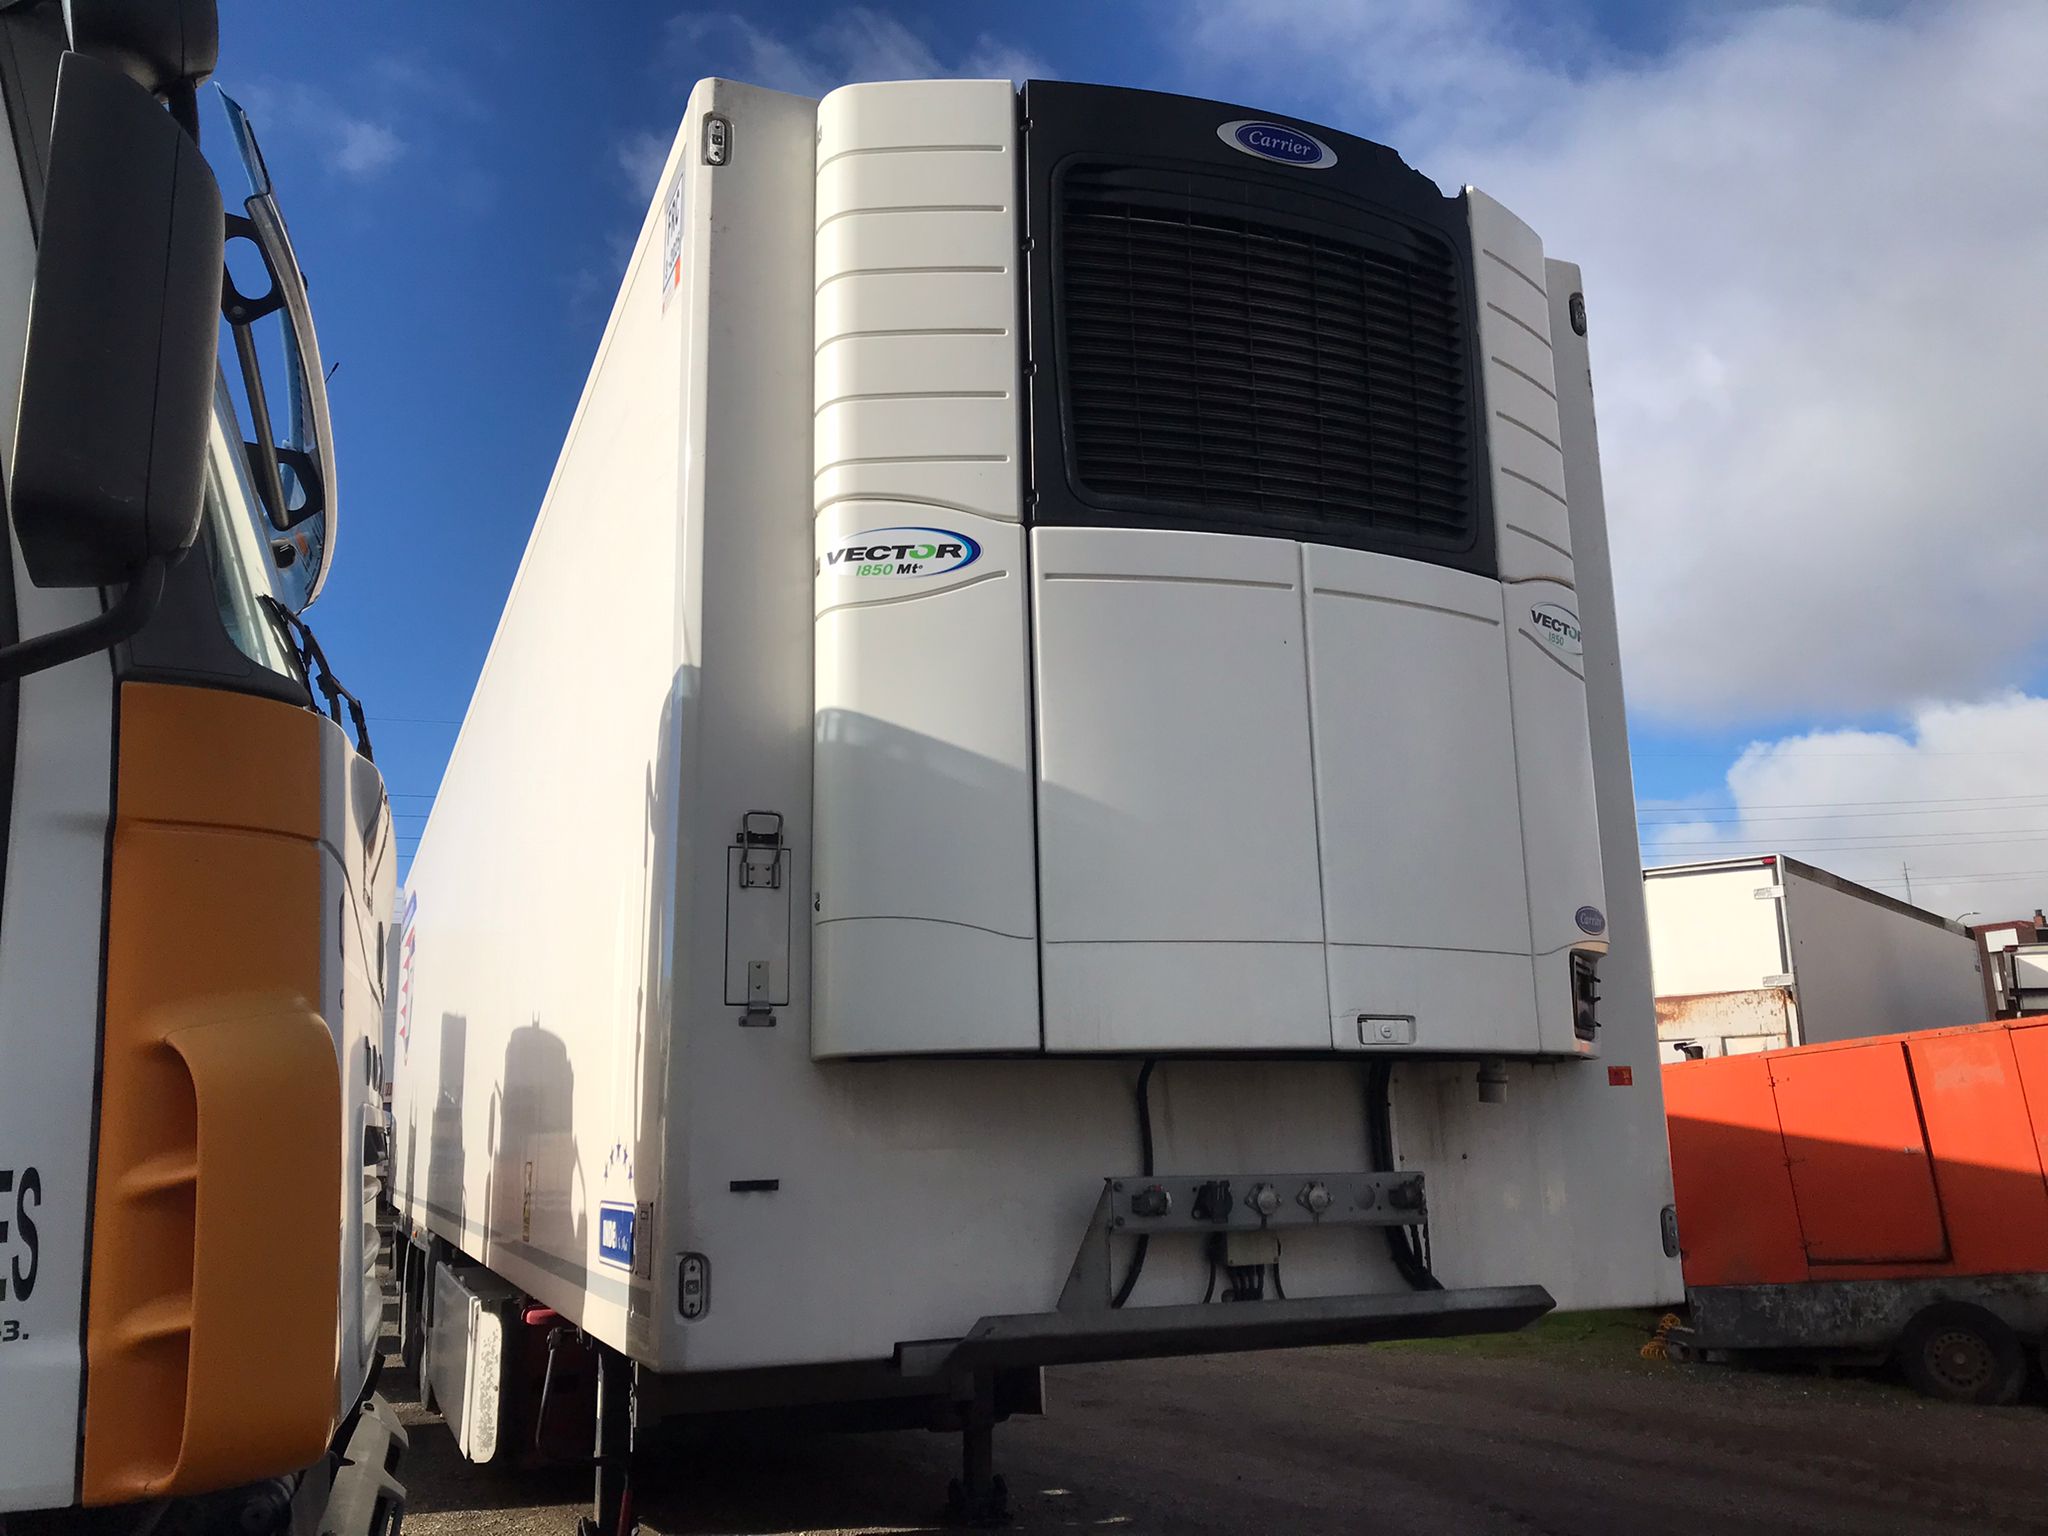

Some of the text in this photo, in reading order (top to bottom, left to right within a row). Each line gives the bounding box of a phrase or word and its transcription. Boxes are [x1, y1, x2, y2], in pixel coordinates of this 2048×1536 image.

[1249, 131, 1311, 155] Carrier
[827, 544, 962, 566] VECTOR
[856, 564, 893, 576] 1850
[1531, 610, 1581, 642] VECTO
